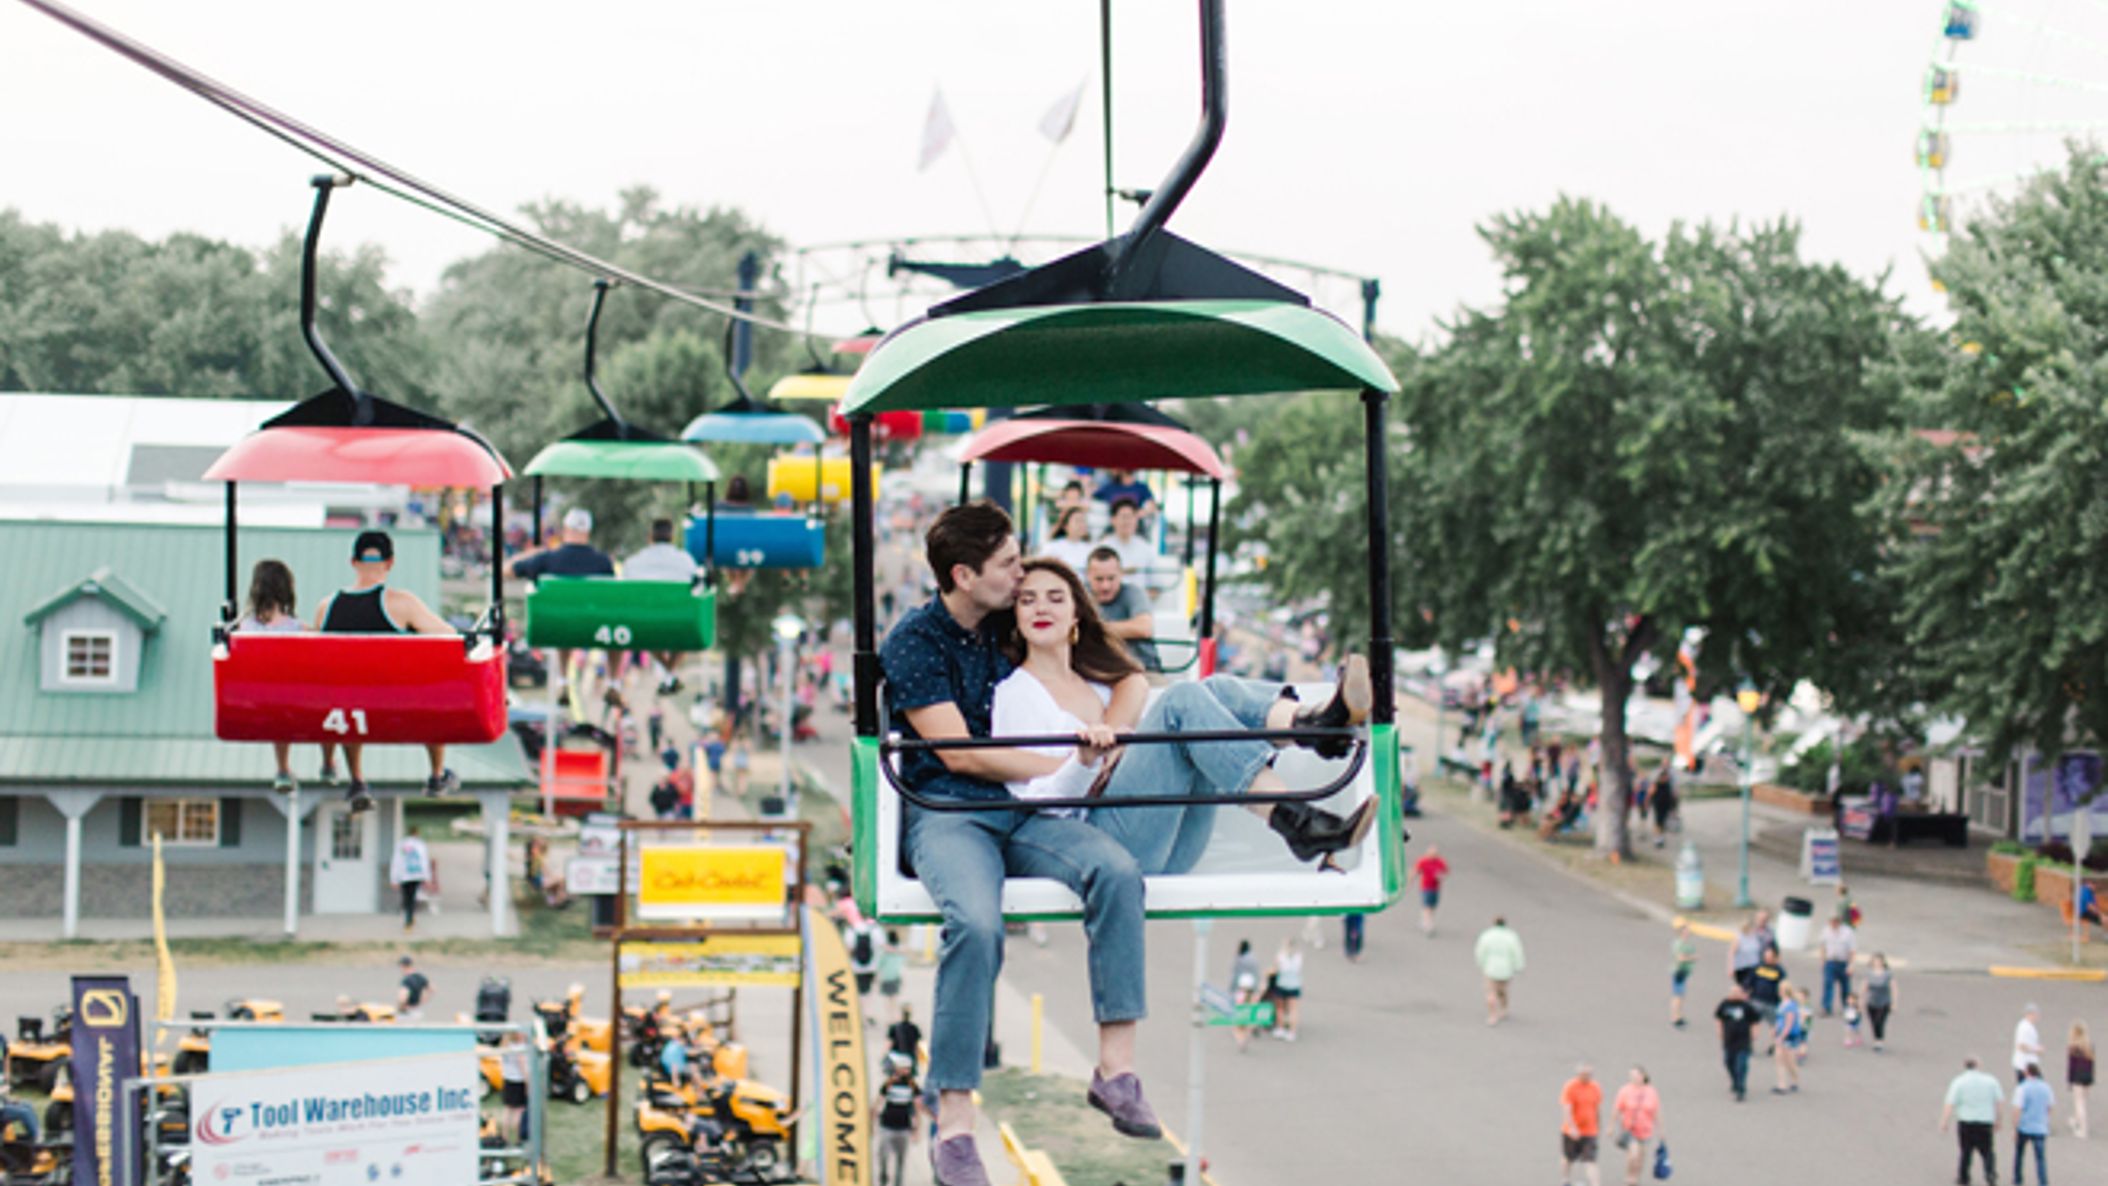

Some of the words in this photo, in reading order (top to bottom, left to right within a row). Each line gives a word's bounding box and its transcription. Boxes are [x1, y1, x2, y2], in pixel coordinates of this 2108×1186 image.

[594, 624, 632, 646] 40
[322, 706, 369, 736] 41
[826, 969, 859, 1184] WELCOME
[250, 1098, 299, 1129] Tool
[303, 1091, 431, 1123] Warehouse
[437, 1086, 474, 1112] Inc.
